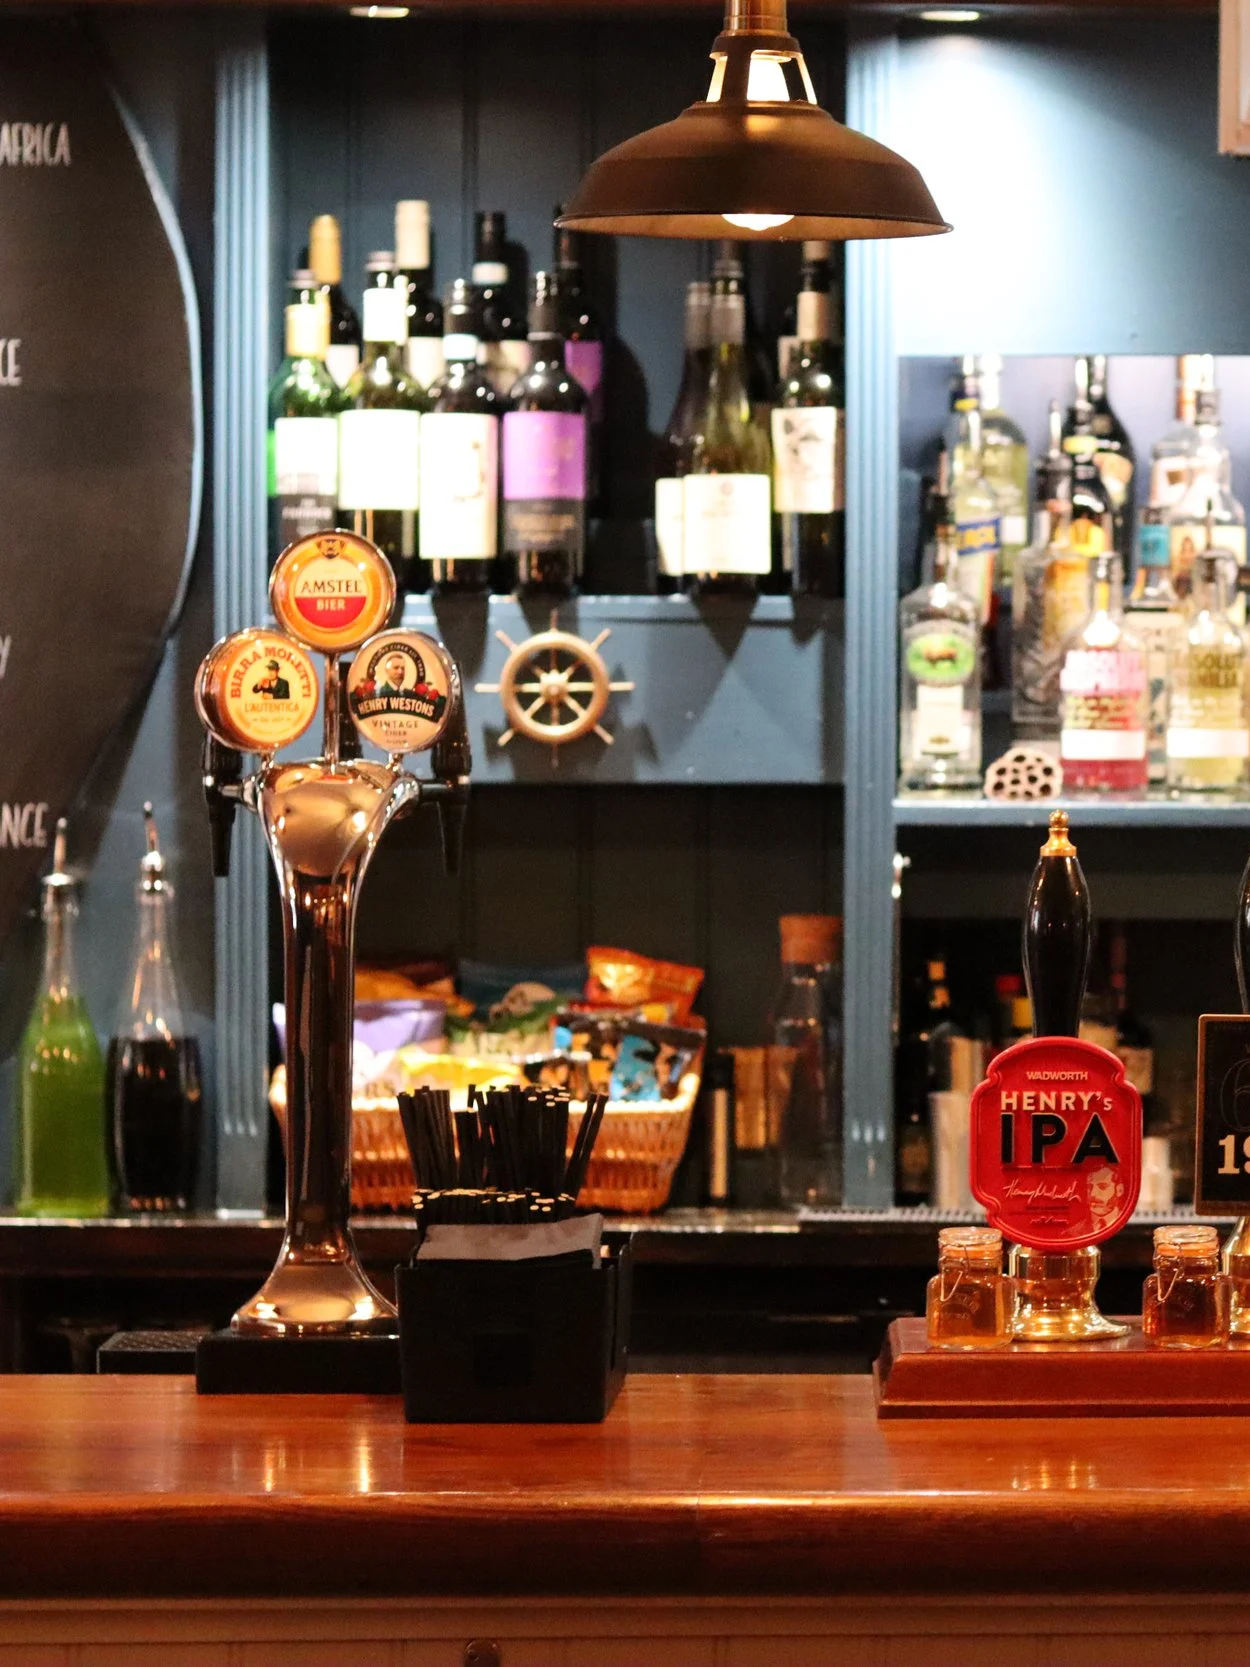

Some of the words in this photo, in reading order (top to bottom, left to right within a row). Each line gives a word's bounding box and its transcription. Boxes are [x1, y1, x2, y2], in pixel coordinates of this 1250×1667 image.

[301, 580, 362, 593] AMSTEL
[316, 599, 346, 611] BIER
[231, 651, 262, 698] BIRRA
[358, 697, 388, 715] HENRY
[389, 697, 435, 717] WESTONS
[372, 720, 419, 729] VINTAGE
[1026, 1071, 1088, 1081] WADWORTH
[1000, 1111, 1121, 1165] IPA
